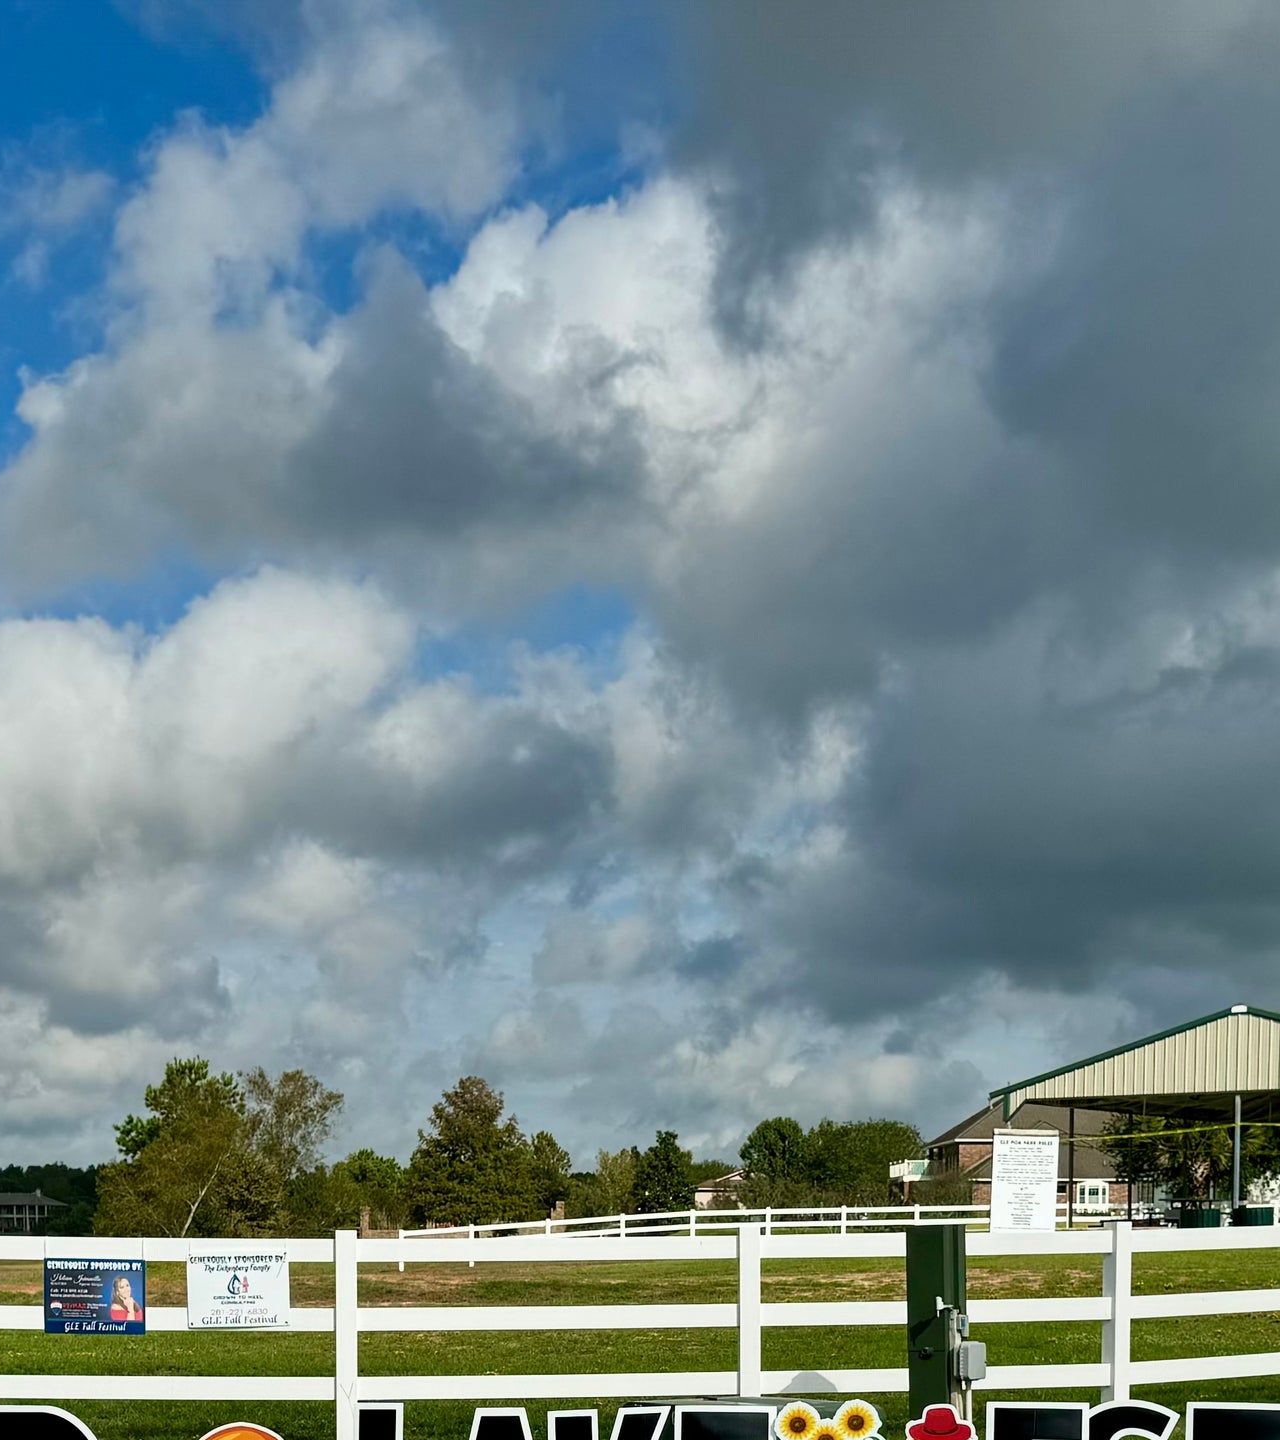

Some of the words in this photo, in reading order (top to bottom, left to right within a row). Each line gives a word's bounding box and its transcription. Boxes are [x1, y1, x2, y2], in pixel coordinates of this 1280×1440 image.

[46, 1260, 89, 1270] GENEROUSLY
[90, 1261, 131, 1271] SPONSORED
[204, 1264, 215, 1273] The
[201, 1316, 222, 1325] GLE
[225, 1315, 241, 1324] Fall
[244, 1314, 278, 1324] Festival
[64, 1321, 81, 1333] GLE
[82, 1320, 98, 1331] Fall
[98, 1321, 127, 1331] Festival
